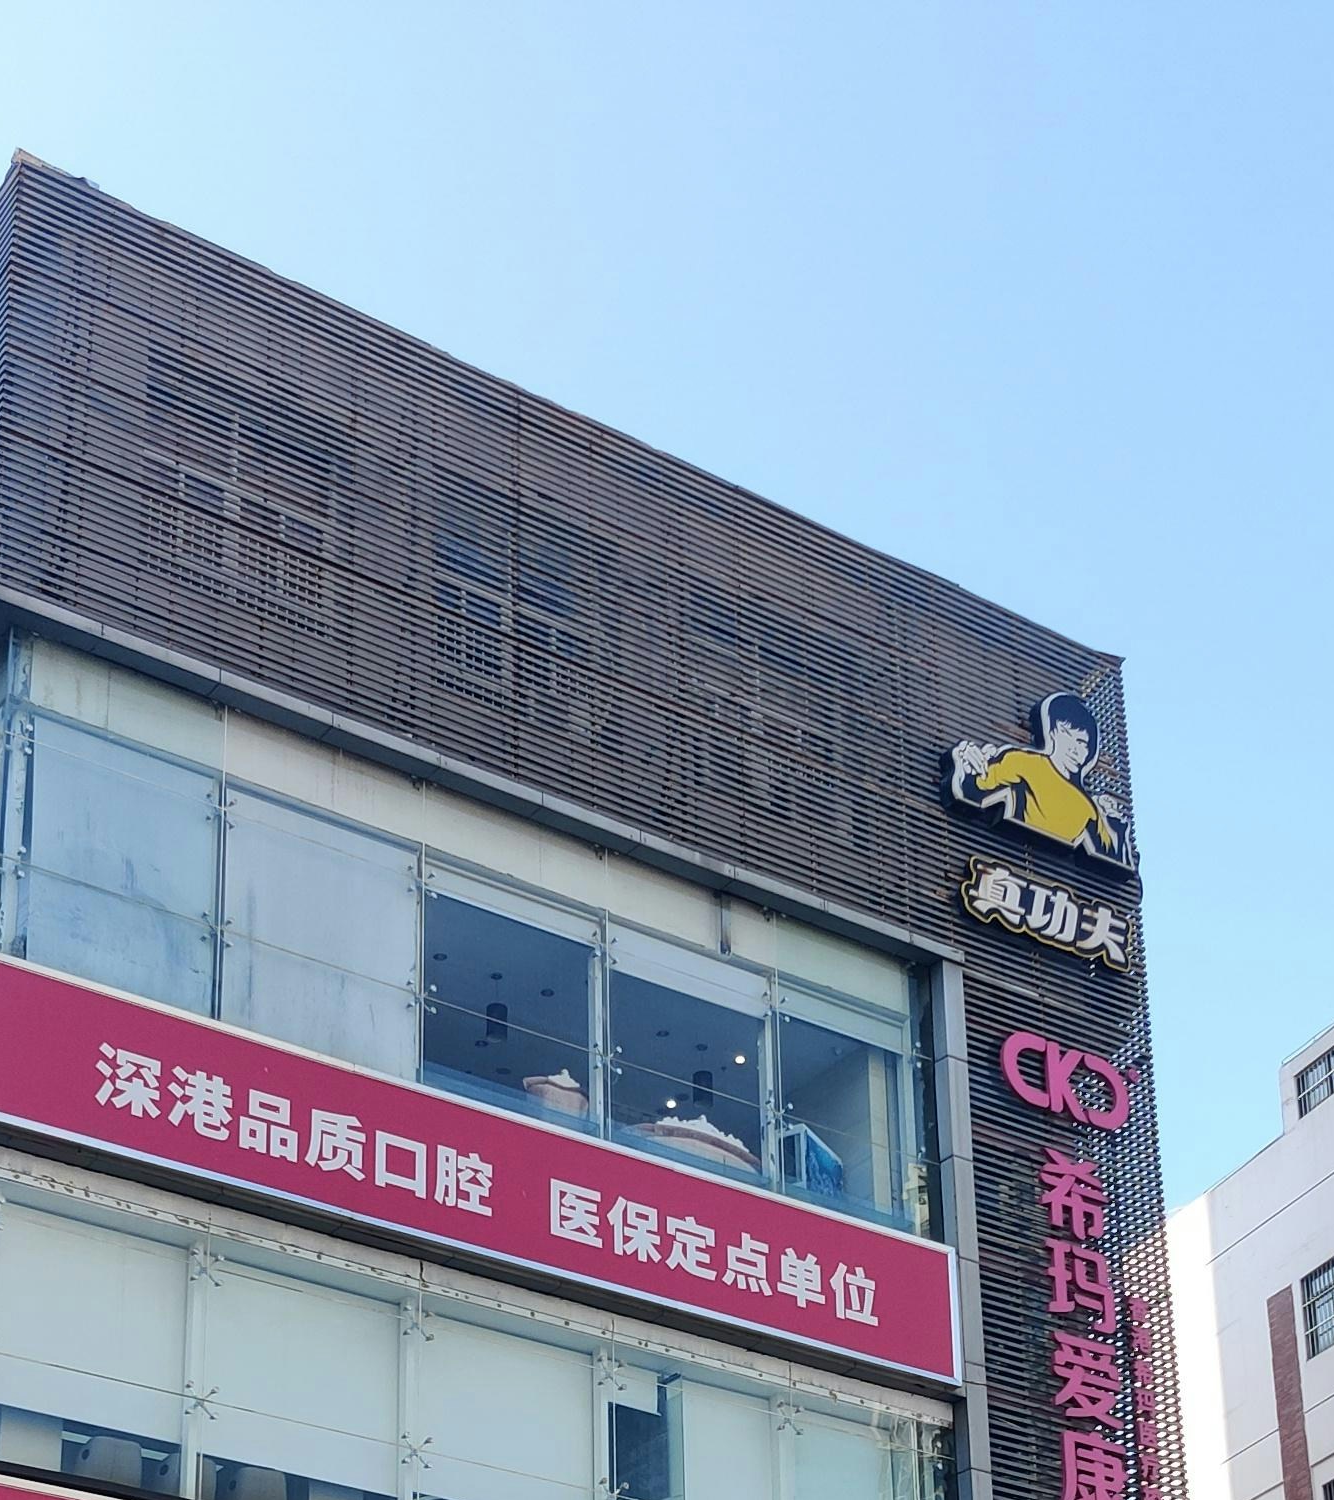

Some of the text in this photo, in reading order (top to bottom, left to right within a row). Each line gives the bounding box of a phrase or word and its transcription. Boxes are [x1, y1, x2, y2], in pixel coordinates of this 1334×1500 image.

[968, 867, 1131, 966] 真功夫
[95, 1042, 880, 1327] 深港品质口腔 医保定点单位
